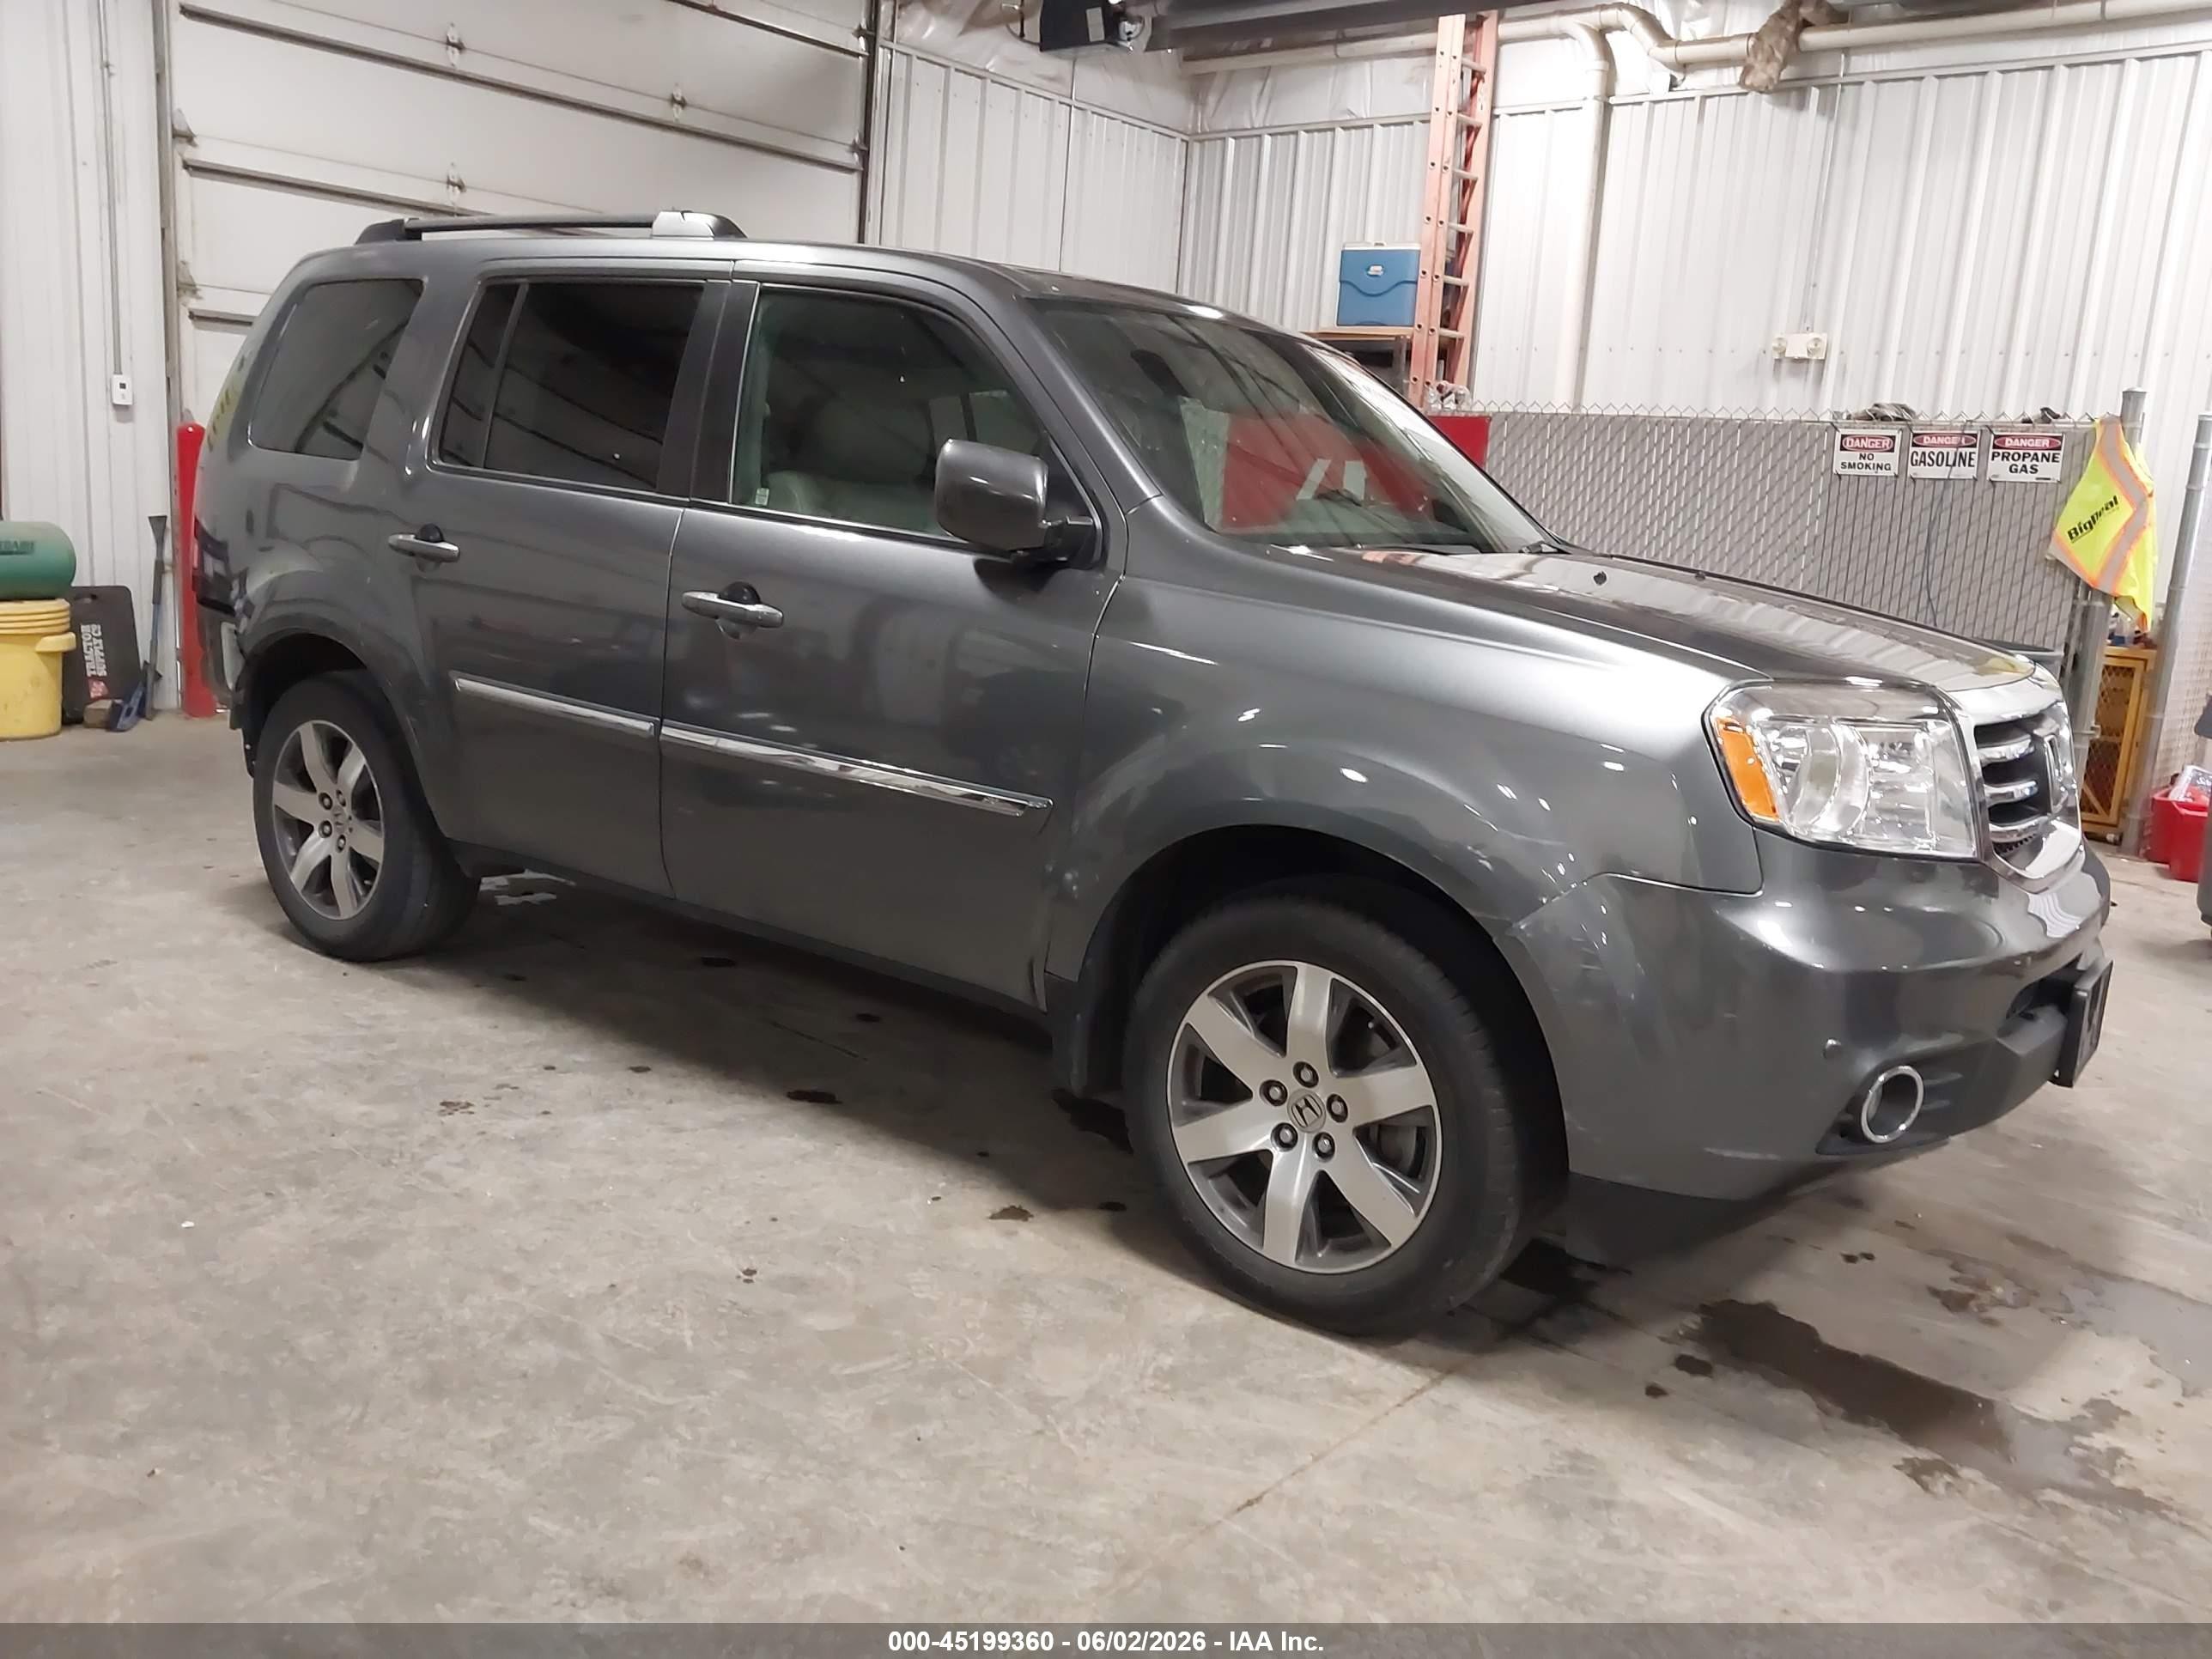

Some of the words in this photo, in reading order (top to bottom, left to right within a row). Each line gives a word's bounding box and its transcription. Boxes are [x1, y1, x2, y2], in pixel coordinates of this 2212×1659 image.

[1846, 438, 1890, 449] DANGER
[2005, 438, 2050, 447] DANGER
[1911, 451, 1977, 468] GASOLINE
[1990, 451, 2060, 464] PROPANE
[1840, 461, 1892, 471] SMOKING
[2008, 464, 2039, 474] GAS
